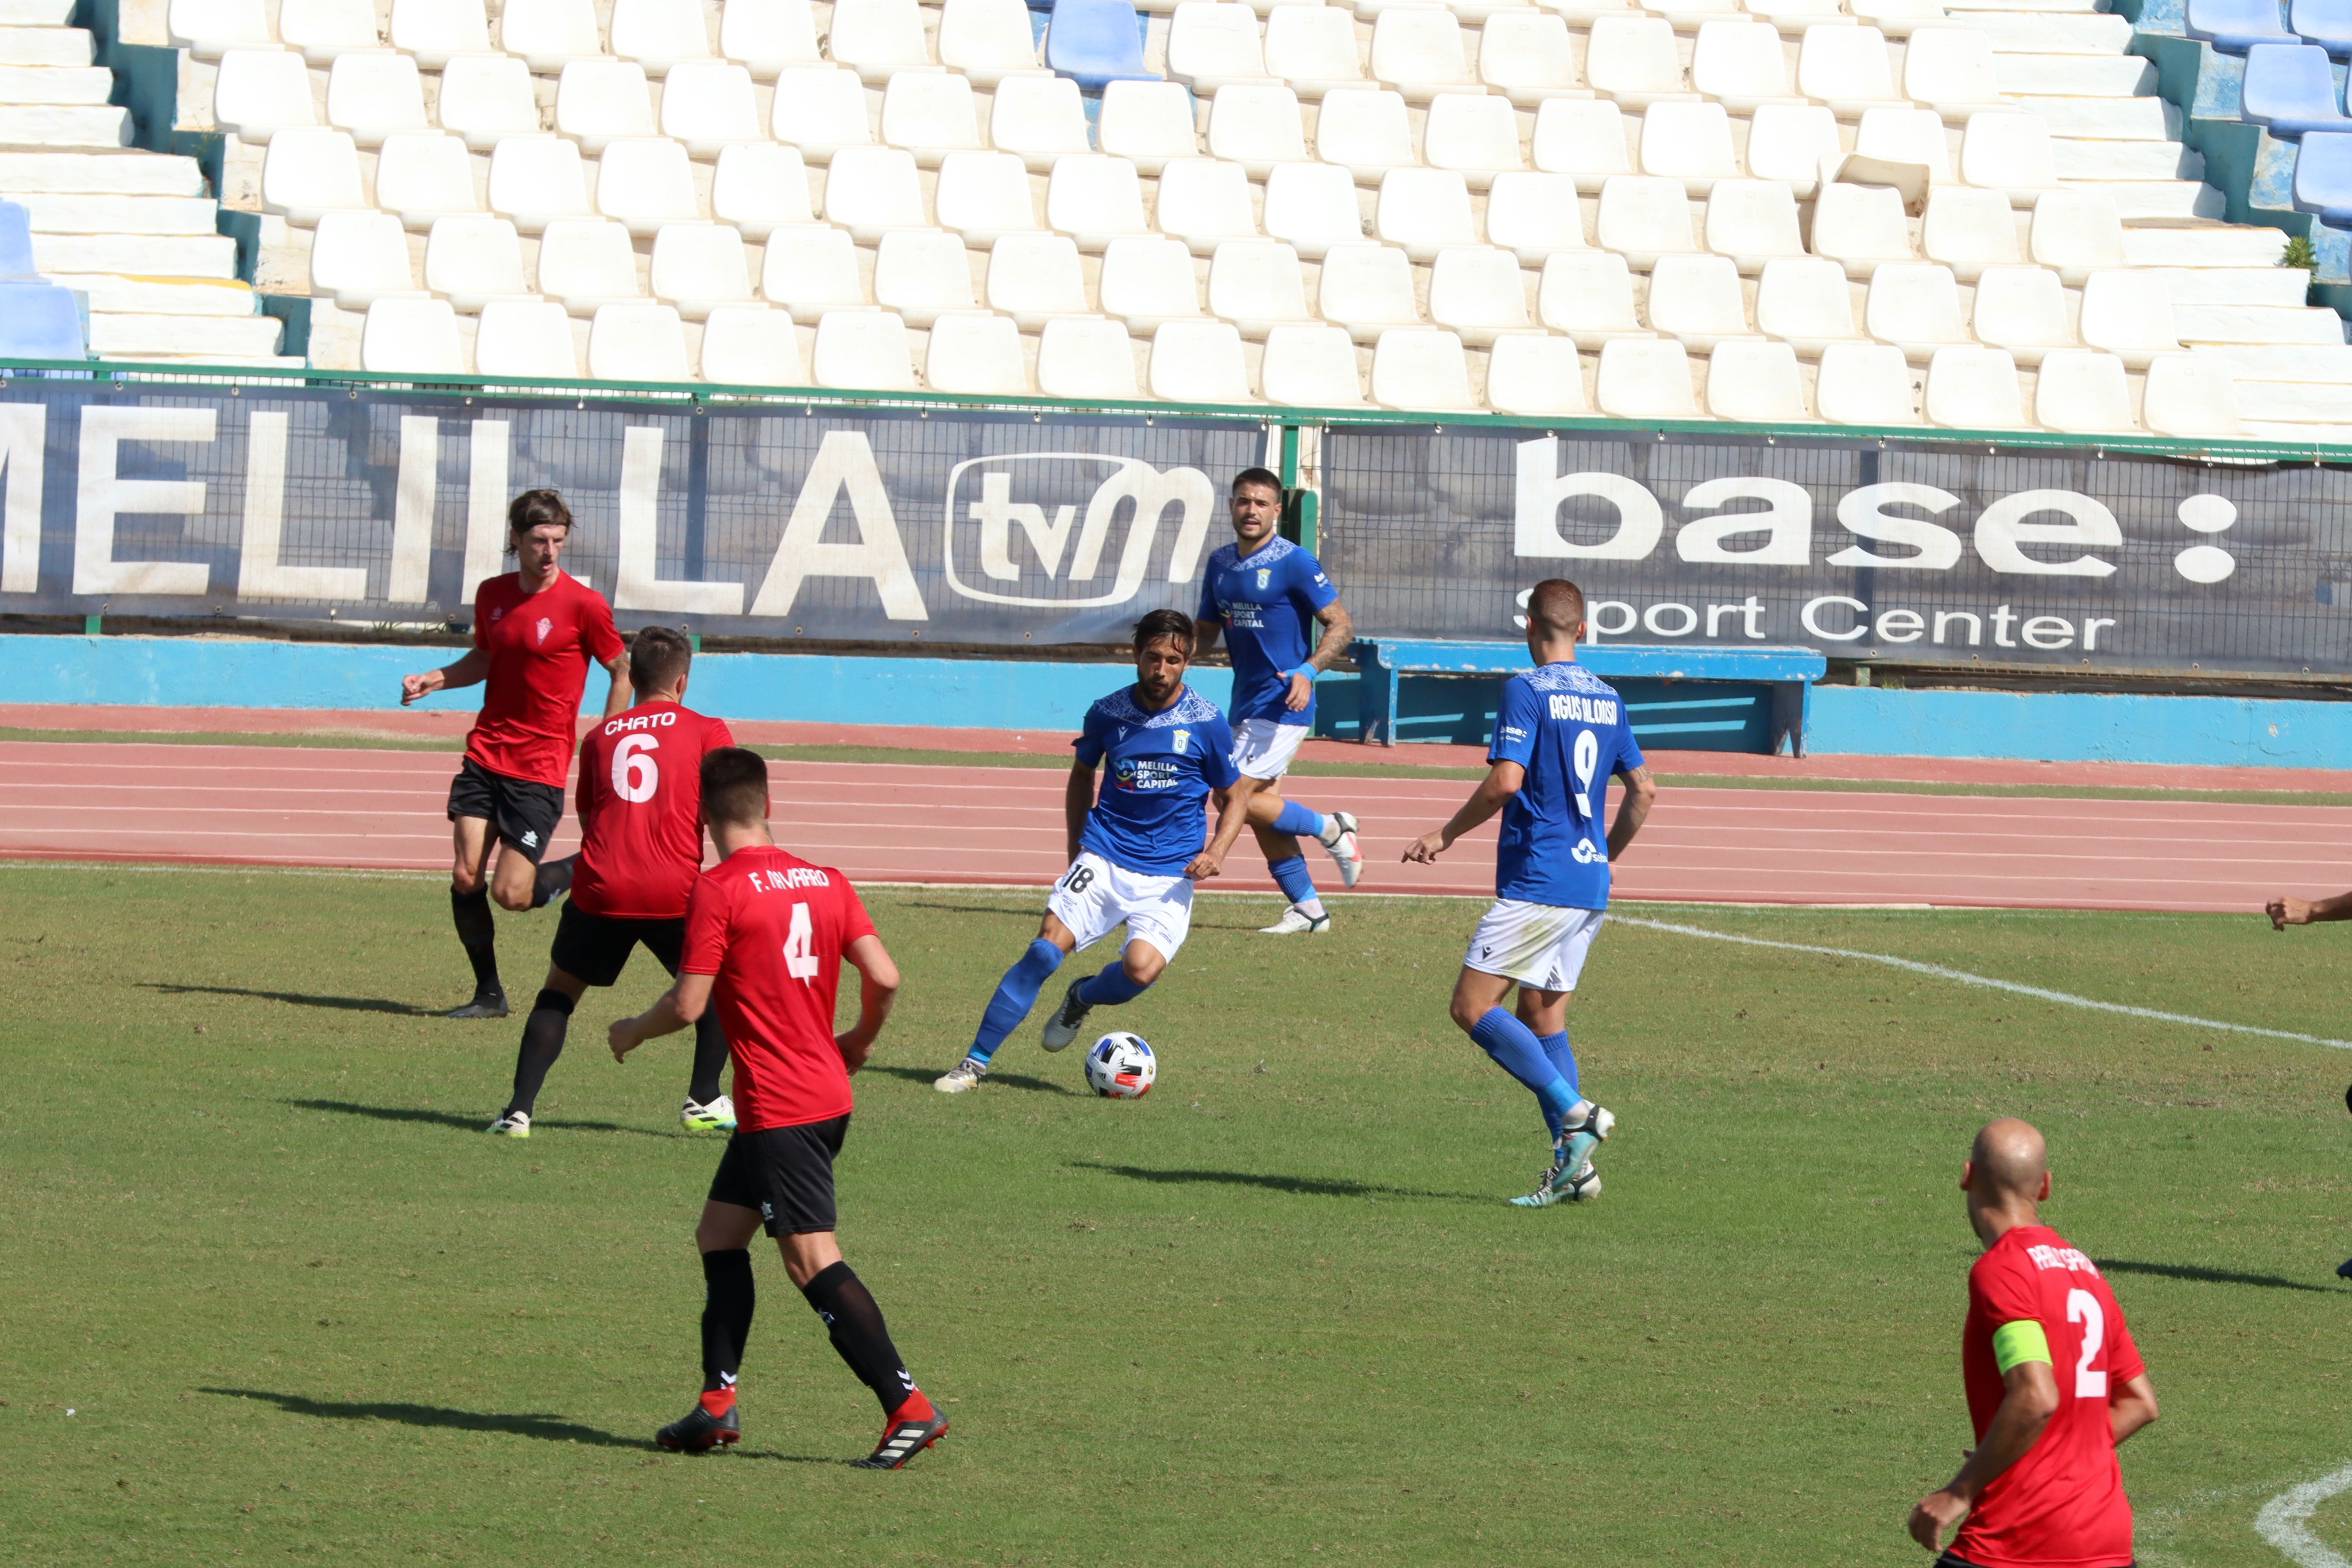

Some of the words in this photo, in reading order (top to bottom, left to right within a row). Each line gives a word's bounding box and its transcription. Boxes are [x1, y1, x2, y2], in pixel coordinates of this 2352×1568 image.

[1233, 610, 1256, 618] SPORT
[1801, 596, 2116, 651] Center
[1549, 694, 1581, 720] AGUS
[605, 711, 676, 735] CHATO
[612, 733, 659, 803] 6
[1137, 771, 1170, 779] SPORT
[1138, 760, 1178, 772] MELILLA
[1574, 729, 1598, 818] 9
[1136, 779, 1178, 788] CAPITAL
[1062, 864, 1094, 893] 18
[783, 901, 818, 988] 4
[2067, 1287, 2107, 1397] 2
